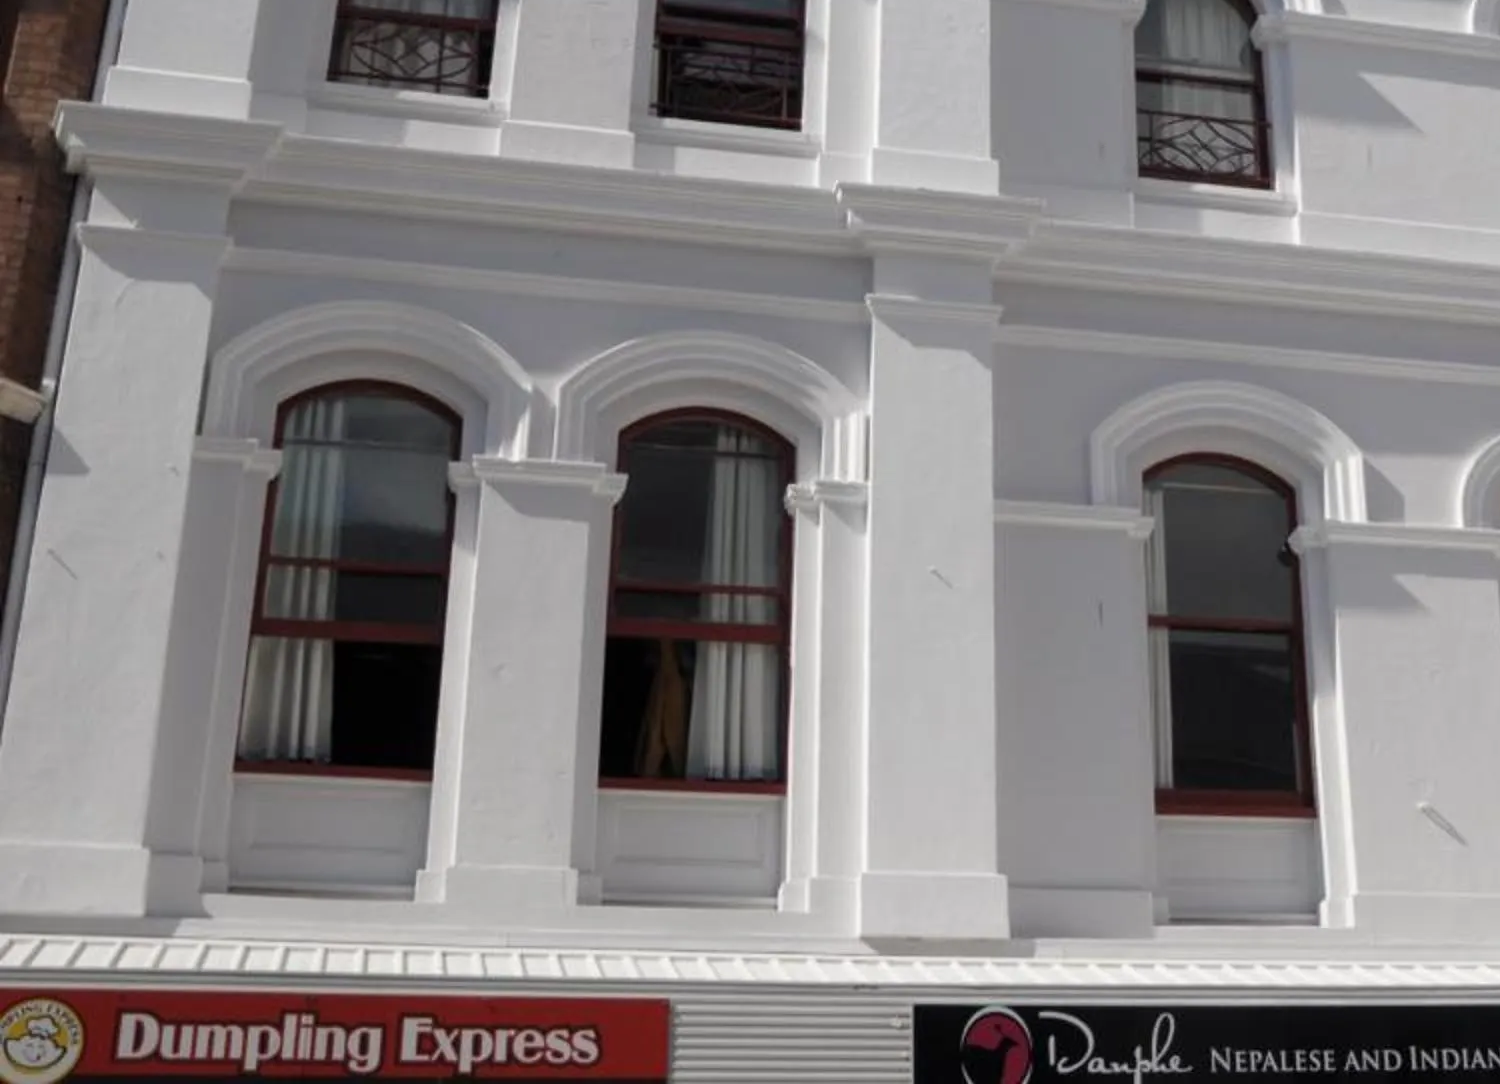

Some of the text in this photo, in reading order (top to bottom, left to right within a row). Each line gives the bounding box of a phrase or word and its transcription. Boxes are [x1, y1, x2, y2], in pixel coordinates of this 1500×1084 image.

[116, 1011, 599, 1073] Dumpling Express
[1209, 1047, 1337, 1074] NEPALESE
[1343, 1048, 1401, 1073] AND
